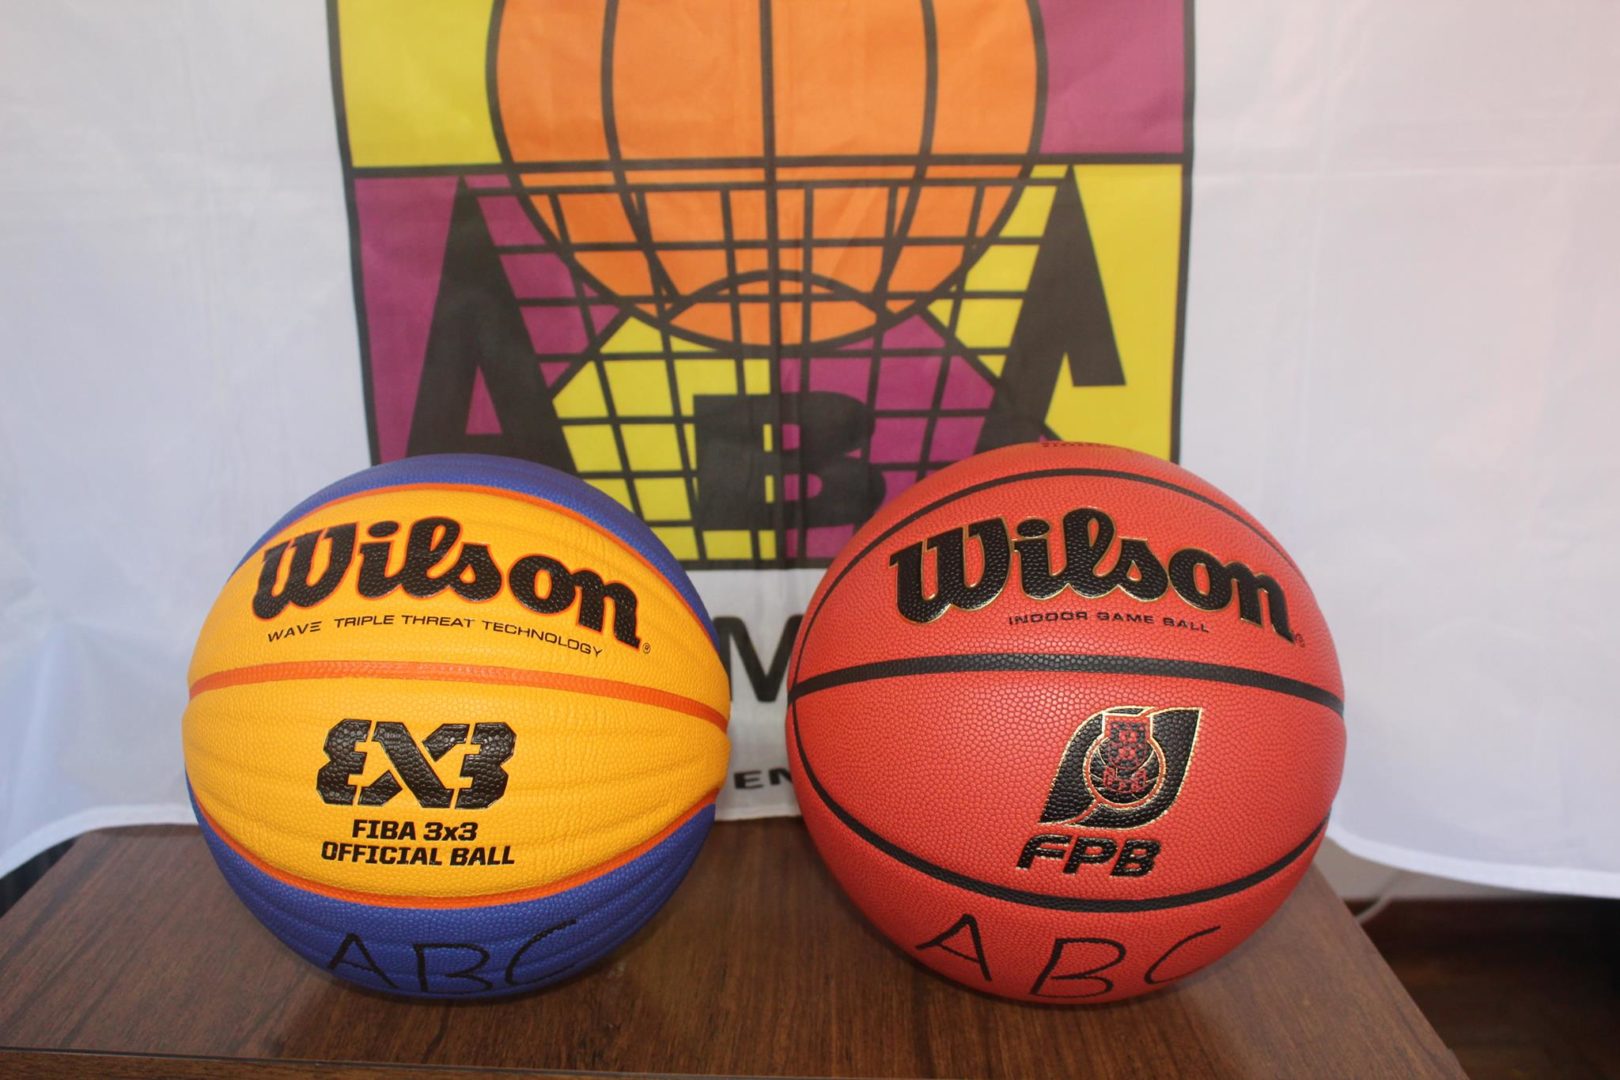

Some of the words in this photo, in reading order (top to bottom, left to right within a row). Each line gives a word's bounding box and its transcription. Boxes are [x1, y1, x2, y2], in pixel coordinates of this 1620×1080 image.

[251, 516, 641, 652] Wilson
[888, 506, 1296, 644] Wilson
[267, 619, 322, 643] WAVE
[334, 614, 394, 629] TRIPLE
[401, 614, 476, 629] THREAT
[482, 619, 604, 657] TECHNOLOGY
[1008, 611, 1089, 627] INDOOR
[1097, 611, 1155, 626] GAME
[1163, 616, 1210, 634] BALL
[352, 819, 417, 841] FIBA
[423, 821, 479, 841] 3x3
[321, 841, 443, 866] OFFICIAL
[449, 845, 516, 867] BALL
[1016, 833, 1163, 878] FPB
